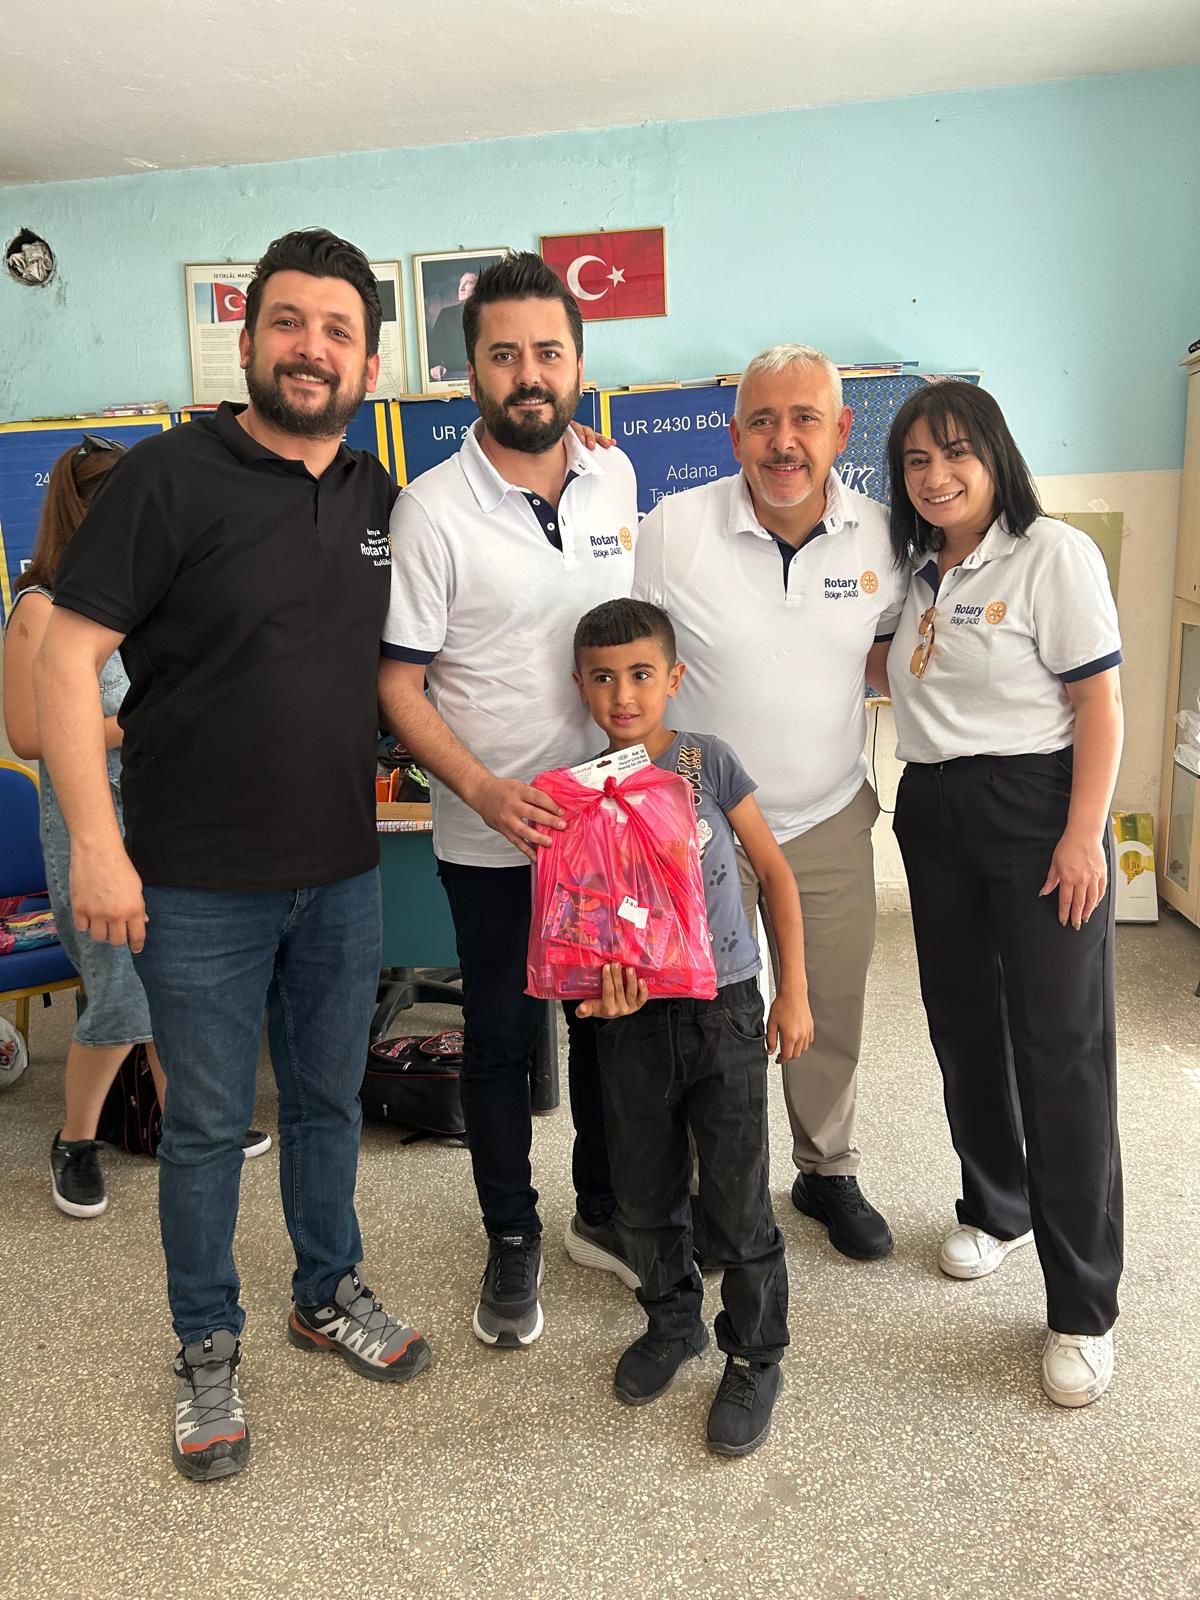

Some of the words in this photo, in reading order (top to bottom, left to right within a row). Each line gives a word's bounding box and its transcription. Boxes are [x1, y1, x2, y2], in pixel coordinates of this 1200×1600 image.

[622, 420, 648, 436] UR
[652, 415, 691, 433] 2430
[696, 410, 731, 430] BÖL
[432, 425, 457, 441] UR
[666, 463, 718, 481] Adana
[590, 535, 619, 547] Rotary
[360, 542, 390, 557] Rotary
[824, 577, 858, 590] Rotary
[824, 590, 842, 600] Bölge
[843, 589, 859, 599] 2430
[954, 603, 985, 618] Rotary
